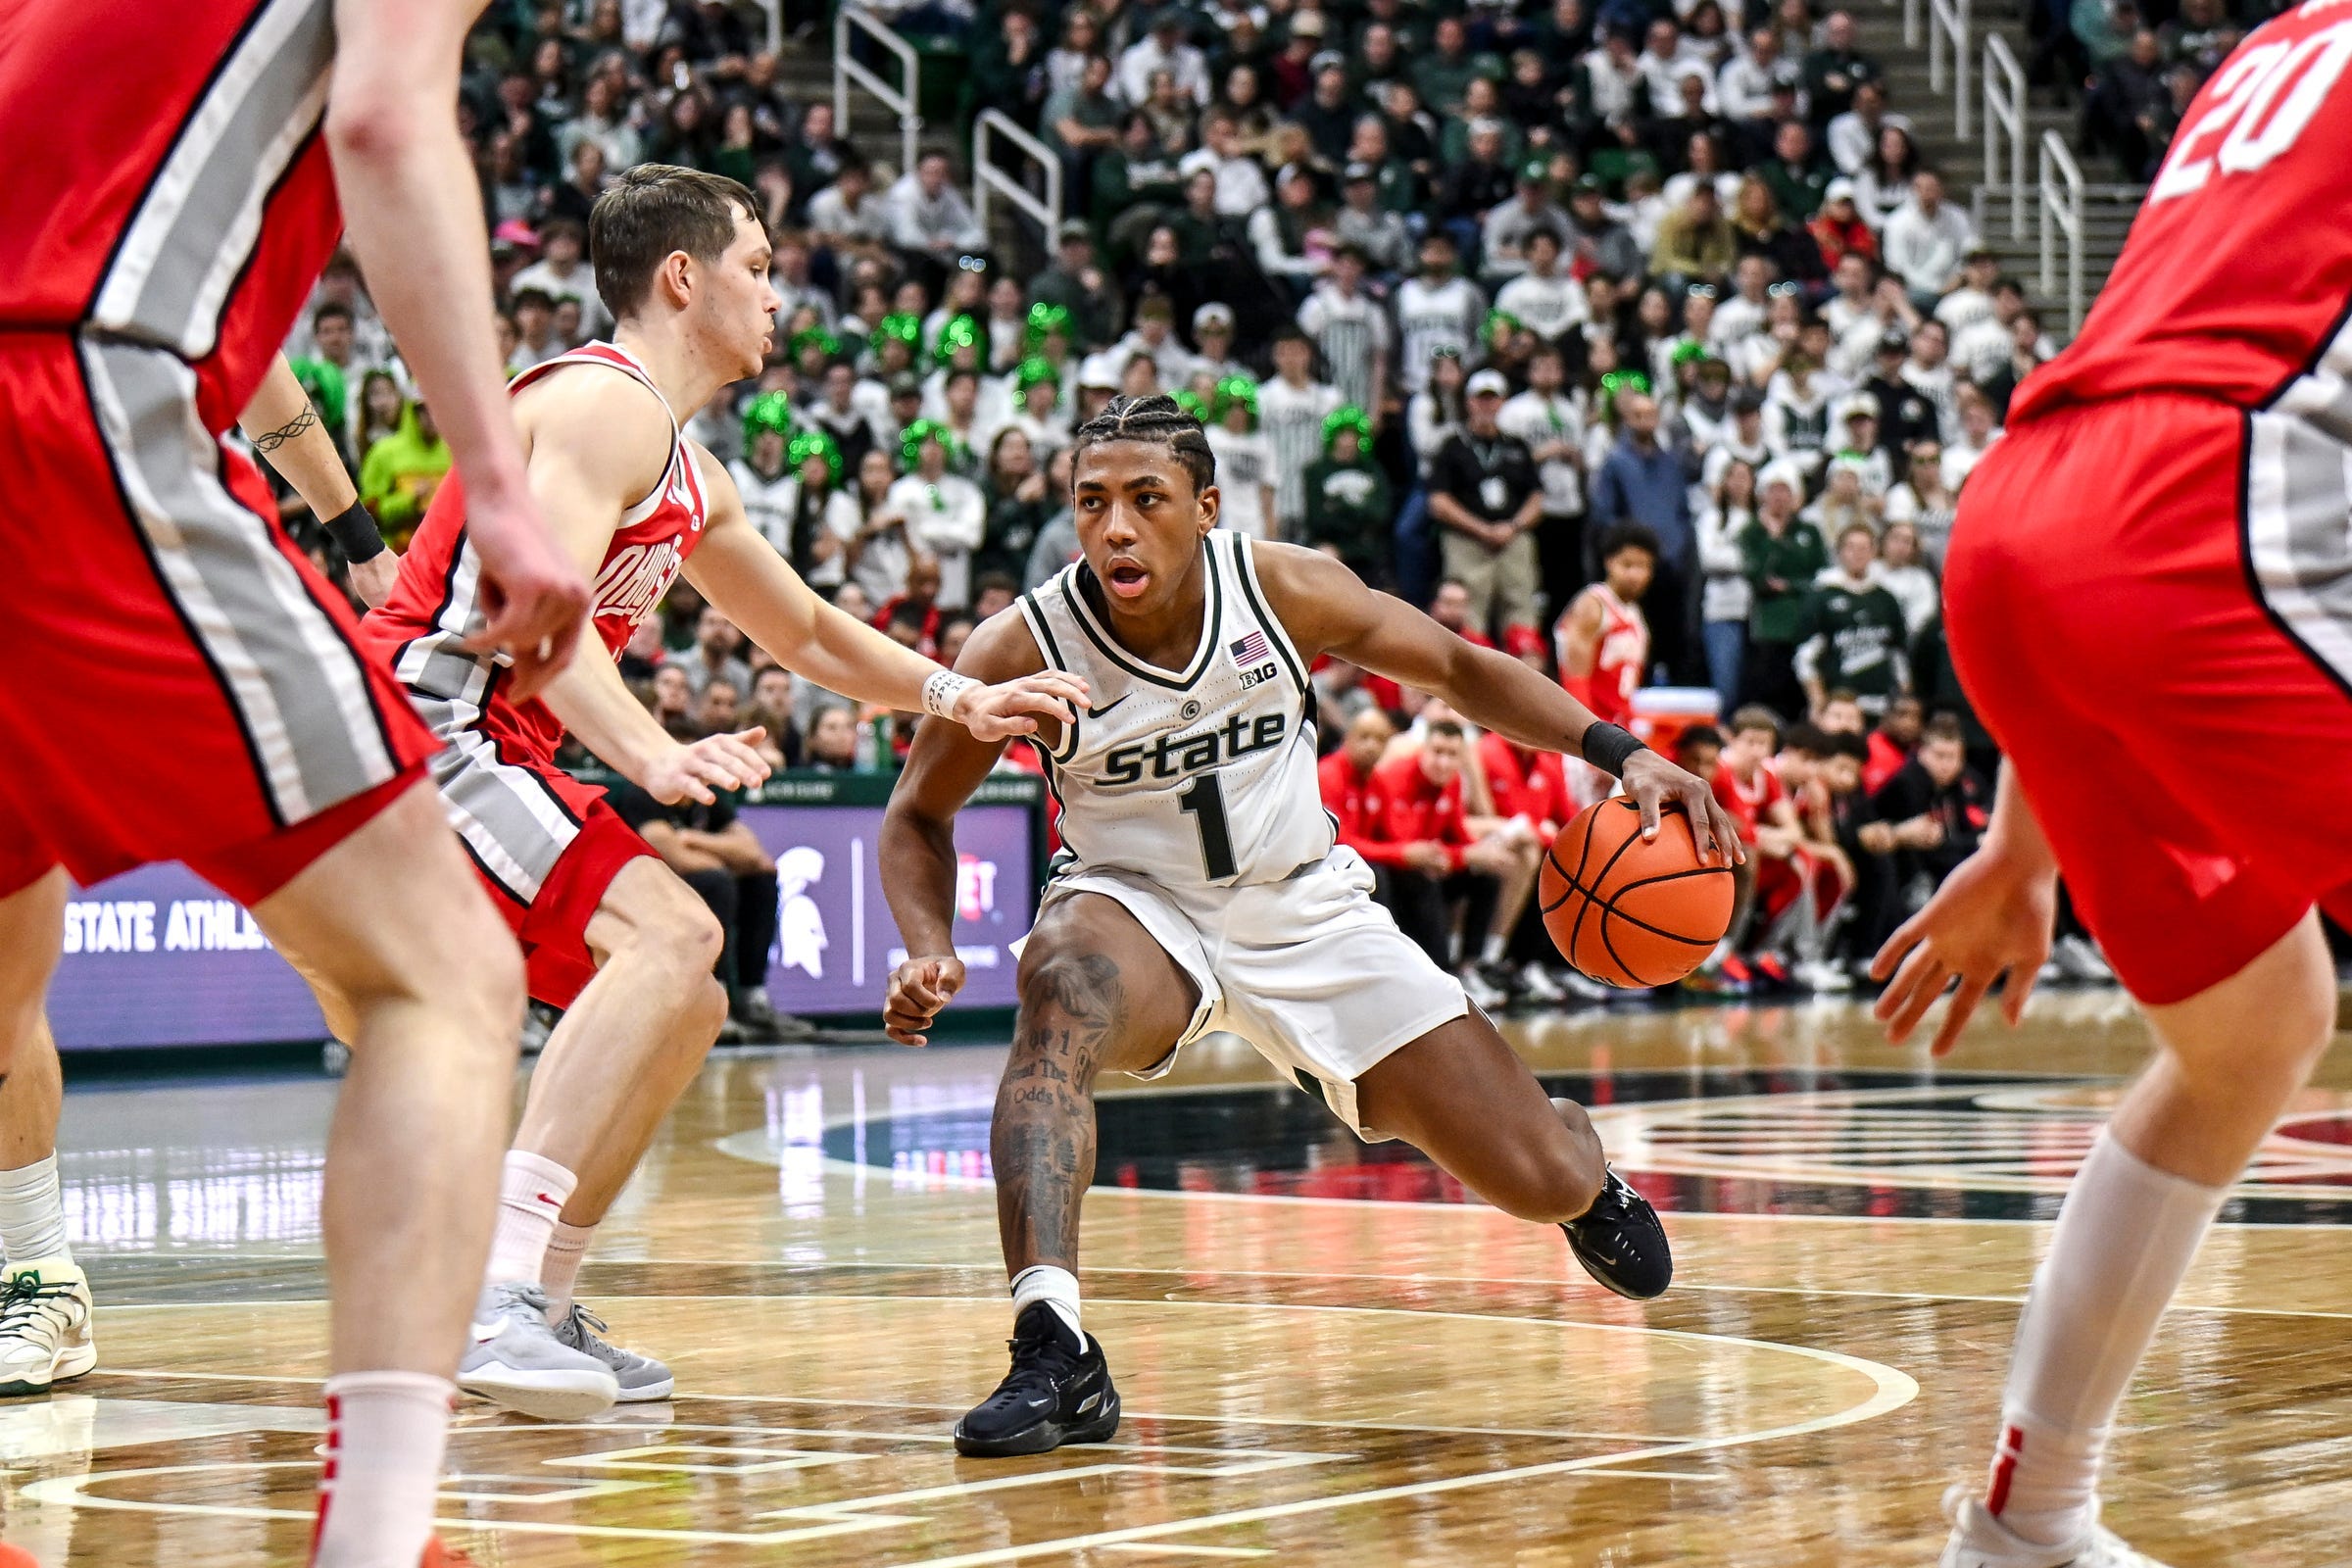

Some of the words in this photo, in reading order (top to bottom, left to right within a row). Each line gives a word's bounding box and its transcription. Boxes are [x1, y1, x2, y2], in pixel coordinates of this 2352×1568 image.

[2149, 20, 2352, 206] 20
[1177, 770, 1239, 881] 1
[64, 902, 156, 954] STATE
[164, 900, 273, 952] ATHLE
[1014, 1086, 1054, 1104] Odds
